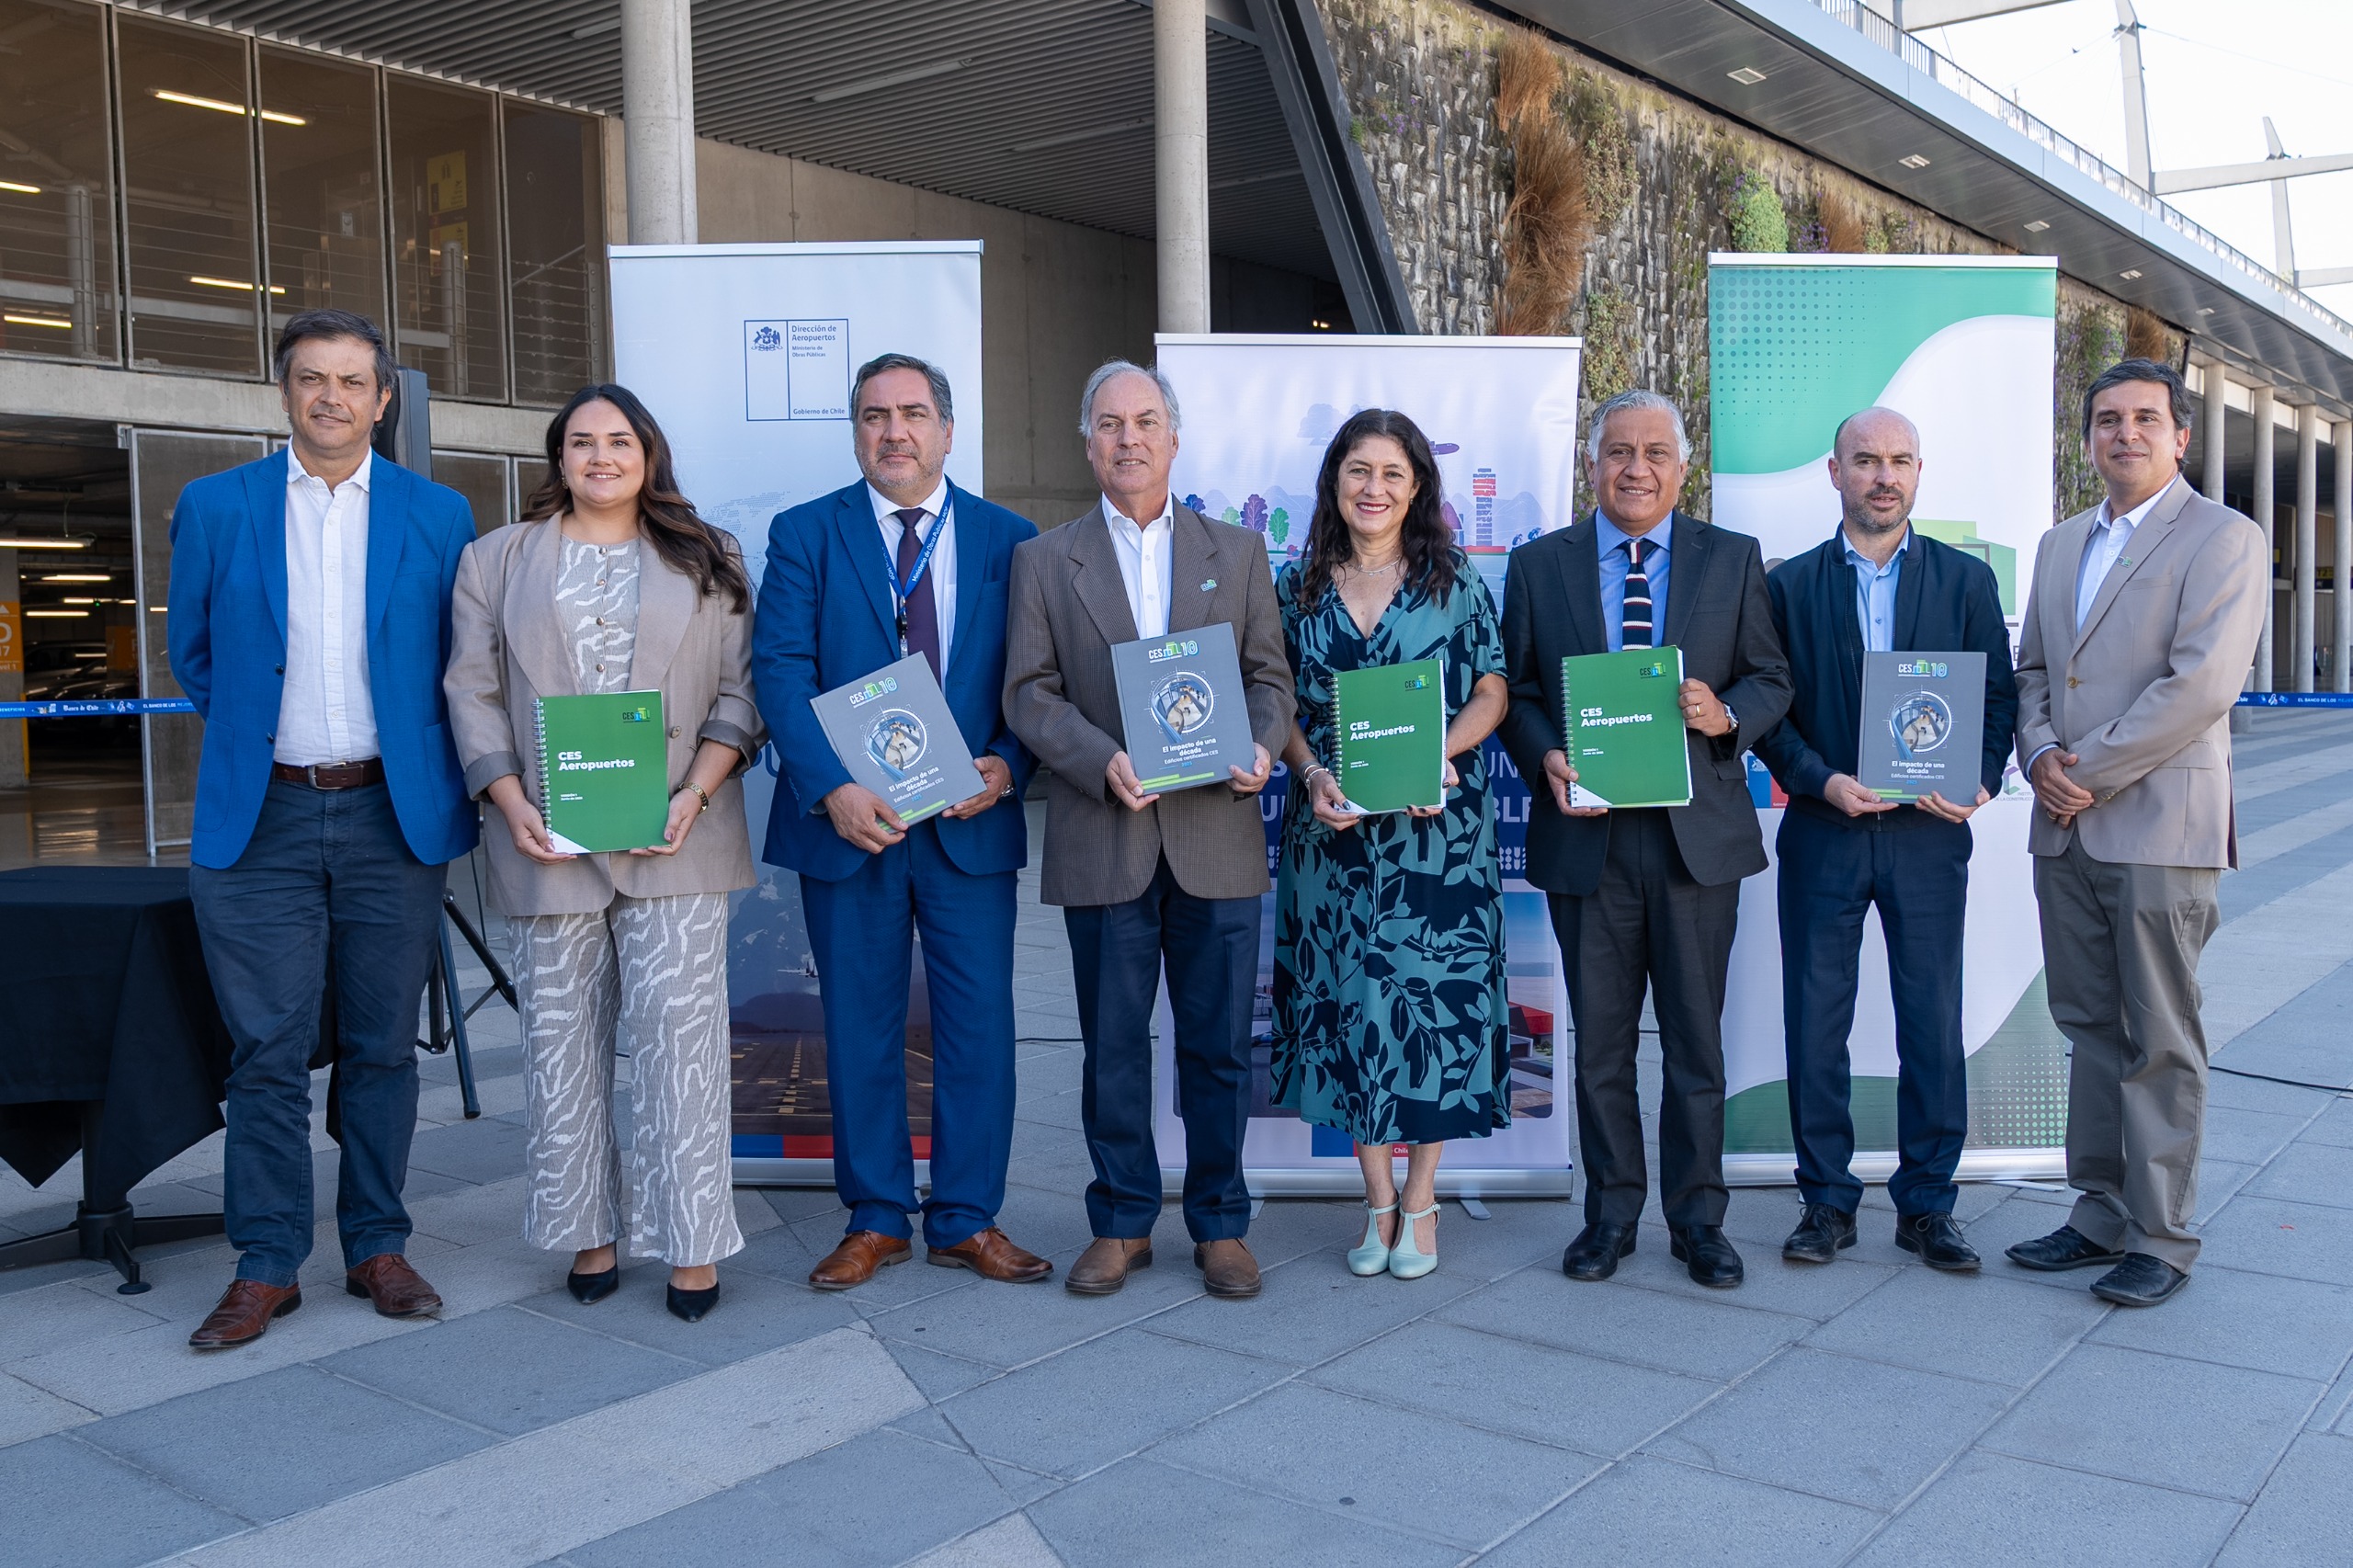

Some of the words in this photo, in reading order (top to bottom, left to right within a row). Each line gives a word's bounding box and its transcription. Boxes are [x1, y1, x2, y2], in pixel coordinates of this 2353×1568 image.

[791, 324, 826, 333] Dirección
[828, 324, 837, 333] de
[1149, 649, 1163, 659] CES
[1181, 640, 1199, 656] 10
[1640, 668, 1651, 676] CES
[1898, 664, 1912, 673] CES
[1931, 662, 1948, 677] 10
[1405, 680, 1416, 688] CES
[849, 692, 864, 705] CES
[879, 677, 897, 694] 10
[622, 712, 635, 720] CES
[1580, 707, 1603, 717] CES
[1581, 714, 1653, 727] Aeropuertos
[1350, 721, 1370, 731] CES
[1350, 725, 1415, 741] Aeropuertos
[1169, 743, 1195, 753] impacto
[1179, 747, 1202, 756] década
[558, 751, 582, 761] CES
[1183, 752, 1209, 761] certificados
[558, 759, 635, 771] Aeropuertos
[888, 784, 896, 793] El
[895, 775, 919, 790] impacto
[919, 771, 928, 779] de
[927, 766, 939, 776] una
[906, 778, 928, 793] década
[893, 791, 912, 804] Edificios
[911, 783, 935, 796] certificados
